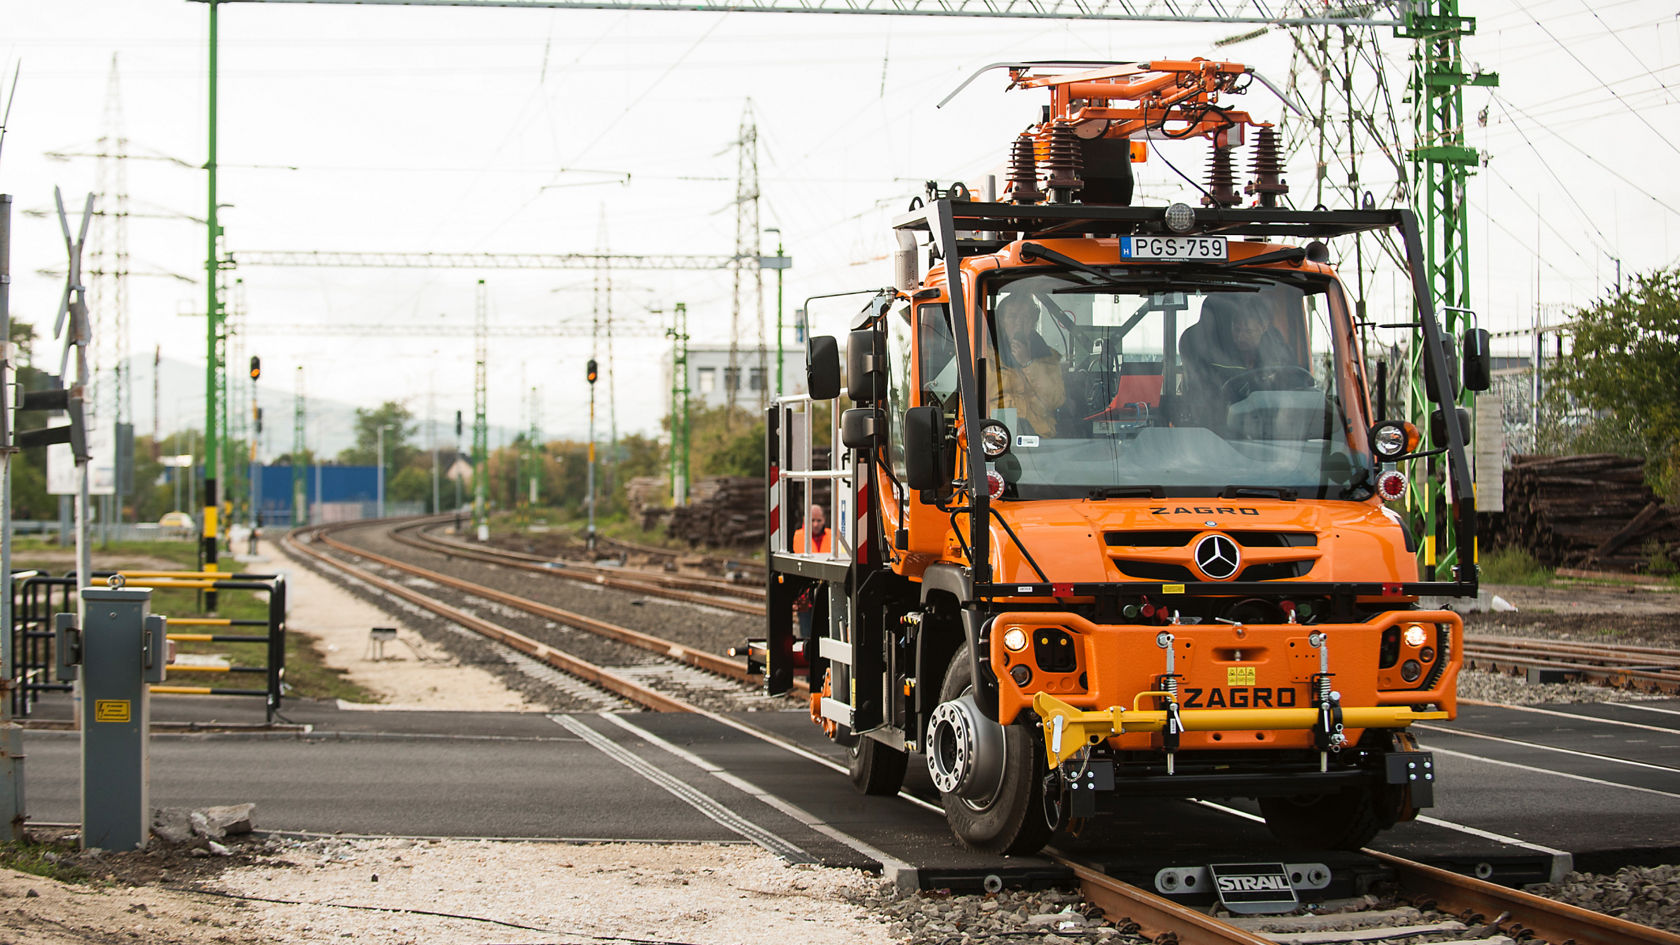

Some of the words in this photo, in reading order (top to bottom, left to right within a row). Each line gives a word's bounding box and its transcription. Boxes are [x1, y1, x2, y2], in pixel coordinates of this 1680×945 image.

[1136, 239, 1222, 256] PGS-759
[1149, 507, 1260, 515] ZAGRO
[1183, 688, 1296, 708] ZAGRO
[1218, 876, 1291, 891] STRAIL
